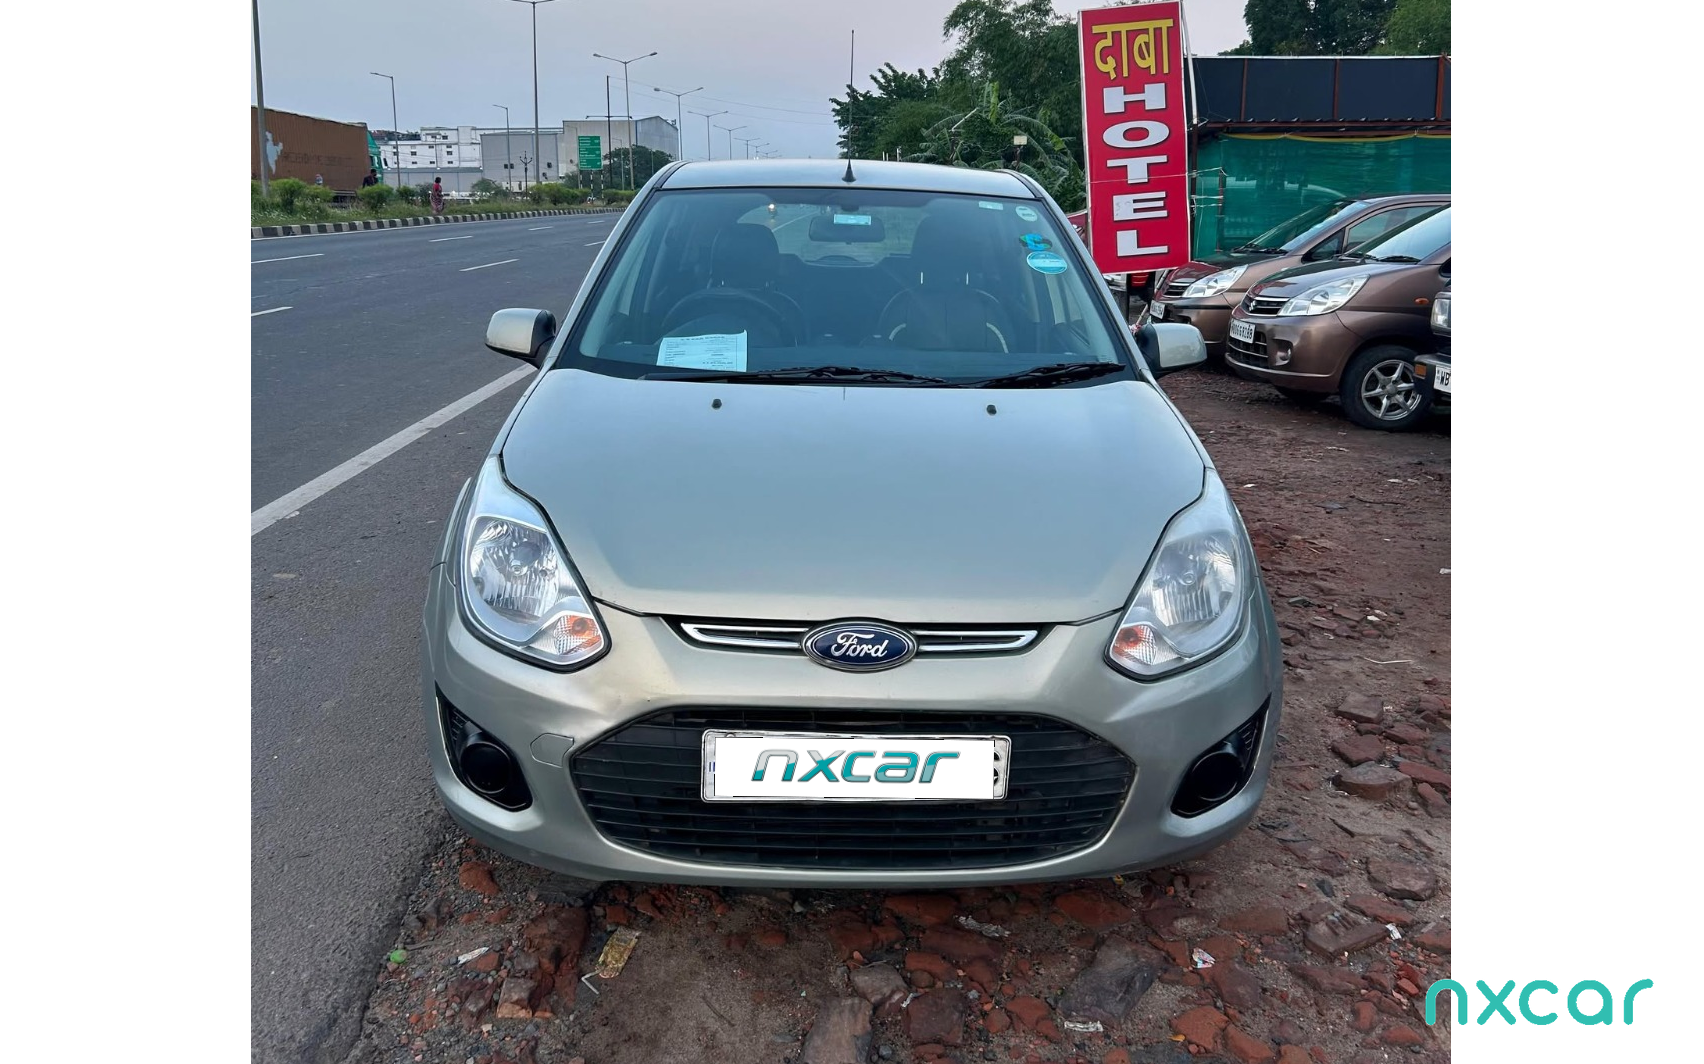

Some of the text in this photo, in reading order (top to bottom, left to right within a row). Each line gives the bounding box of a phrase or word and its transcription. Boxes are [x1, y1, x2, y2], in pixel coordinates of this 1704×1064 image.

[1092, 18, 1174, 80] दाबा
[1103, 82, 1170, 257] HOTEL
[1439, 370, 1451, 387] WB
[830, 631, 889, 658] Ford
